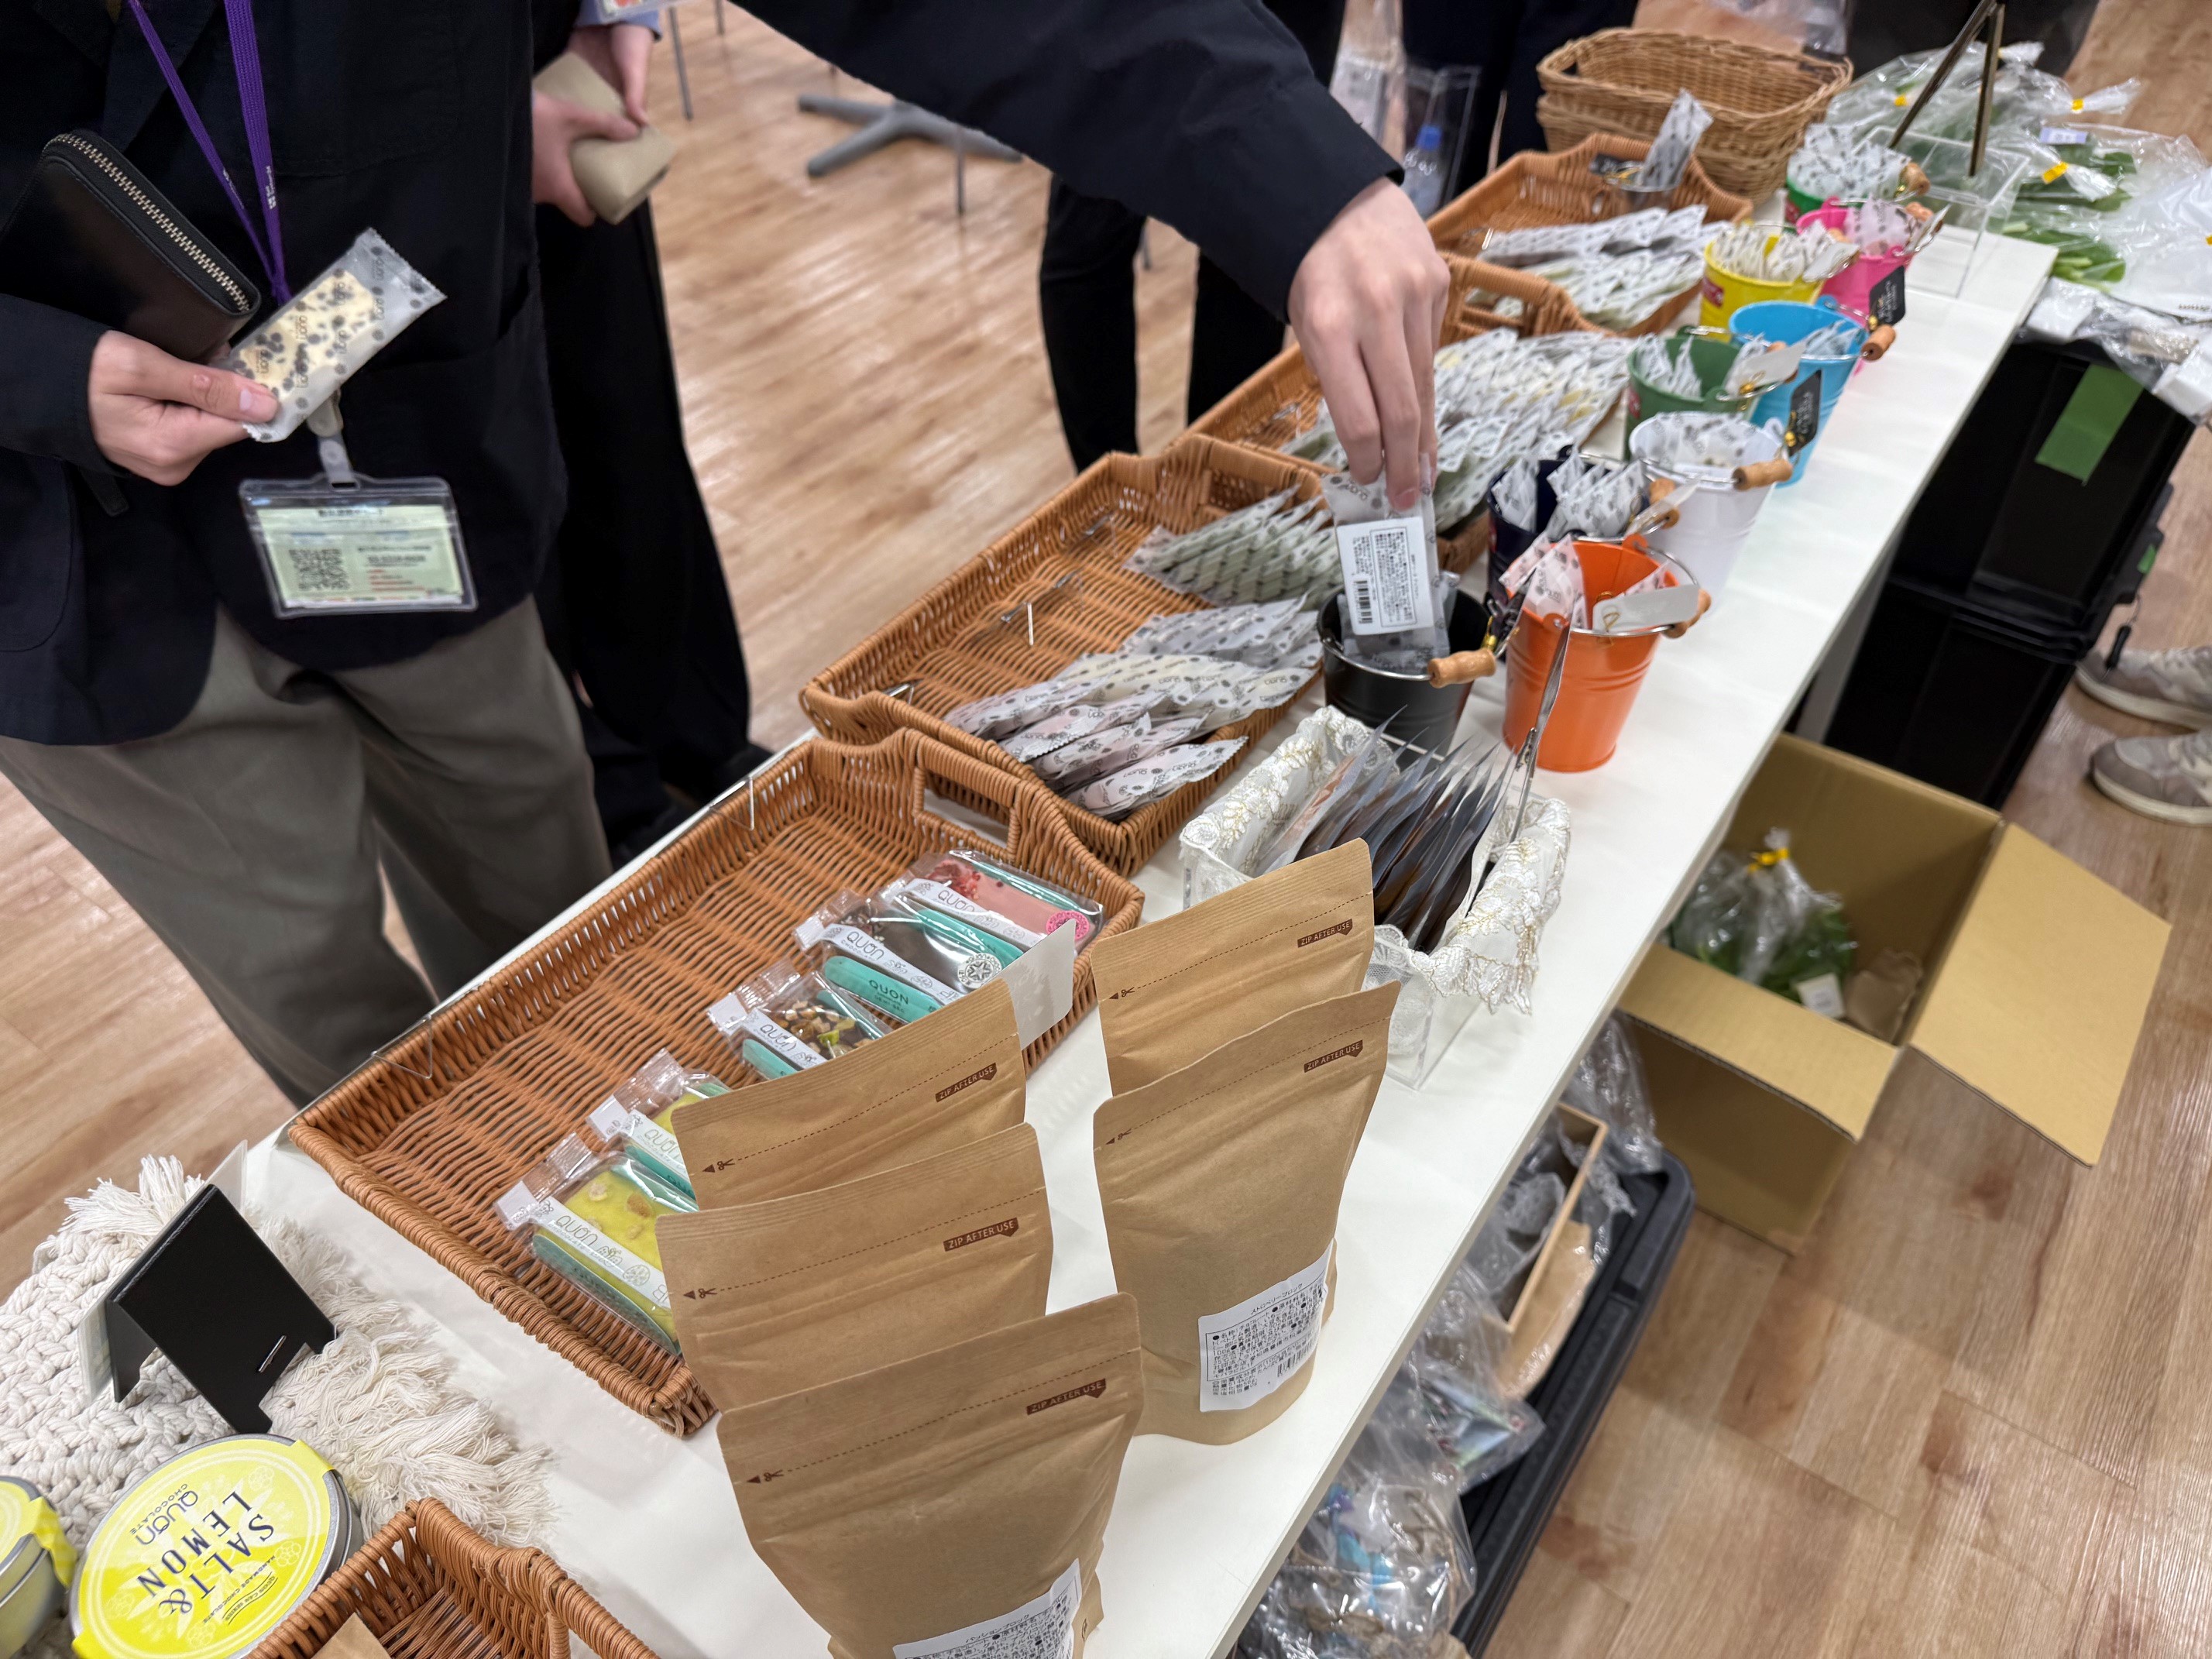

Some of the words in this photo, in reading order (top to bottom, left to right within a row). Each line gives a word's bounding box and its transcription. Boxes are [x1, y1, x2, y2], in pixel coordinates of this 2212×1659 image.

[1301, 936, 1312, 945] ZIP
[1314, 928, 1335, 940] AFTER
[1337, 921, 1350, 931] USE
[869, 980, 909, 1005] QUON
[1307, 1060, 1319, 1070] ZIP
[1321, 1050, 1344, 1063] AFTER
[1345, 1043, 1360, 1053] USE
[939, 1088, 952, 1099] ZIP
[953, 1076, 977, 1093] AFTER
[979, 1066, 994, 1078] USE
[949, 1237, 963, 1249] ZIP
[966, 1228, 994, 1243] AFTER
[997, 1221, 1014, 1232] USE
[1032, 1402, 1046, 1412] ZIP
[1050, 1389, 1080, 1405] AFTER
[1083, 1381, 1101, 1393] USE
[129, 1483, 188, 1535] CHOCOLATE
[137, 1491, 253, 1599] LEMON
